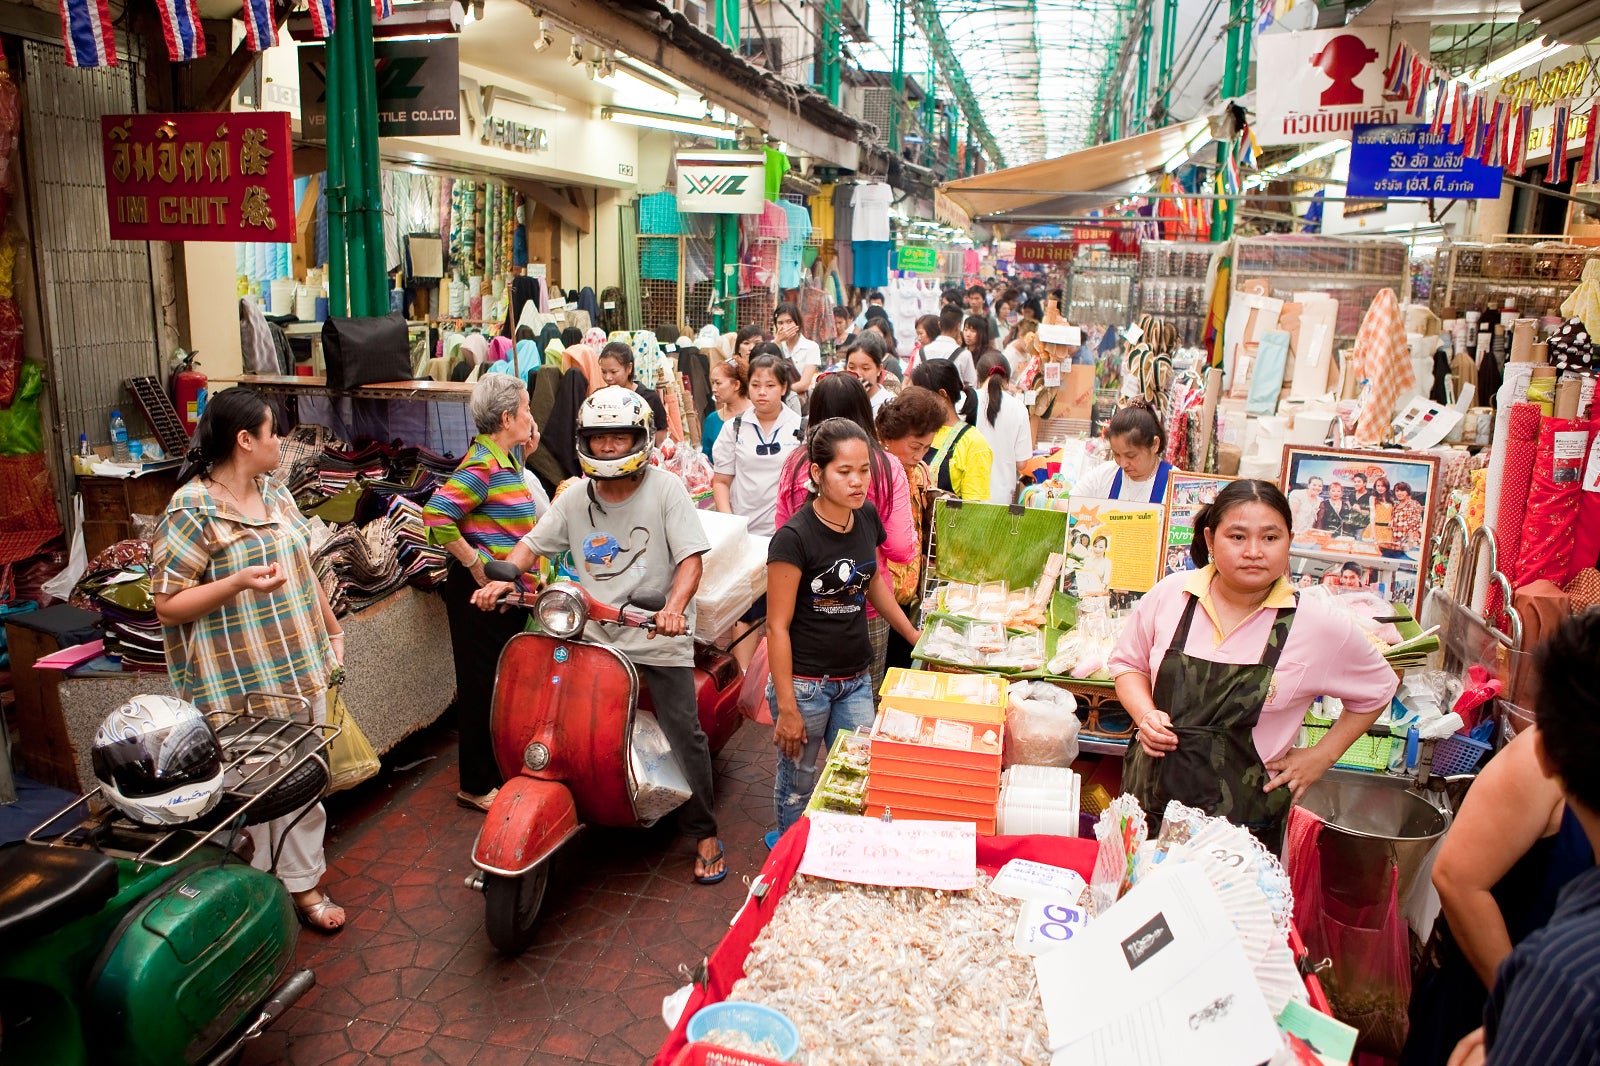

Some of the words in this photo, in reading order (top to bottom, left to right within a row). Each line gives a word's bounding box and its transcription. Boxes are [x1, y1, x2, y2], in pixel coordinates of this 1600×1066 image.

[411, 109, 456, 122] CO.,LTD.
[1390, 151, 1406, 168] รับ
[1411, 151, 1429, 168] อัด
[1374, 178, 1402, 191] บริษัท
[1447, 180, 1474, 192] จำกัด
[118, 196, 148, 224] IM
[159, 196, 229, 225] CHIT
[1040, 904, 1080, 940] 50
